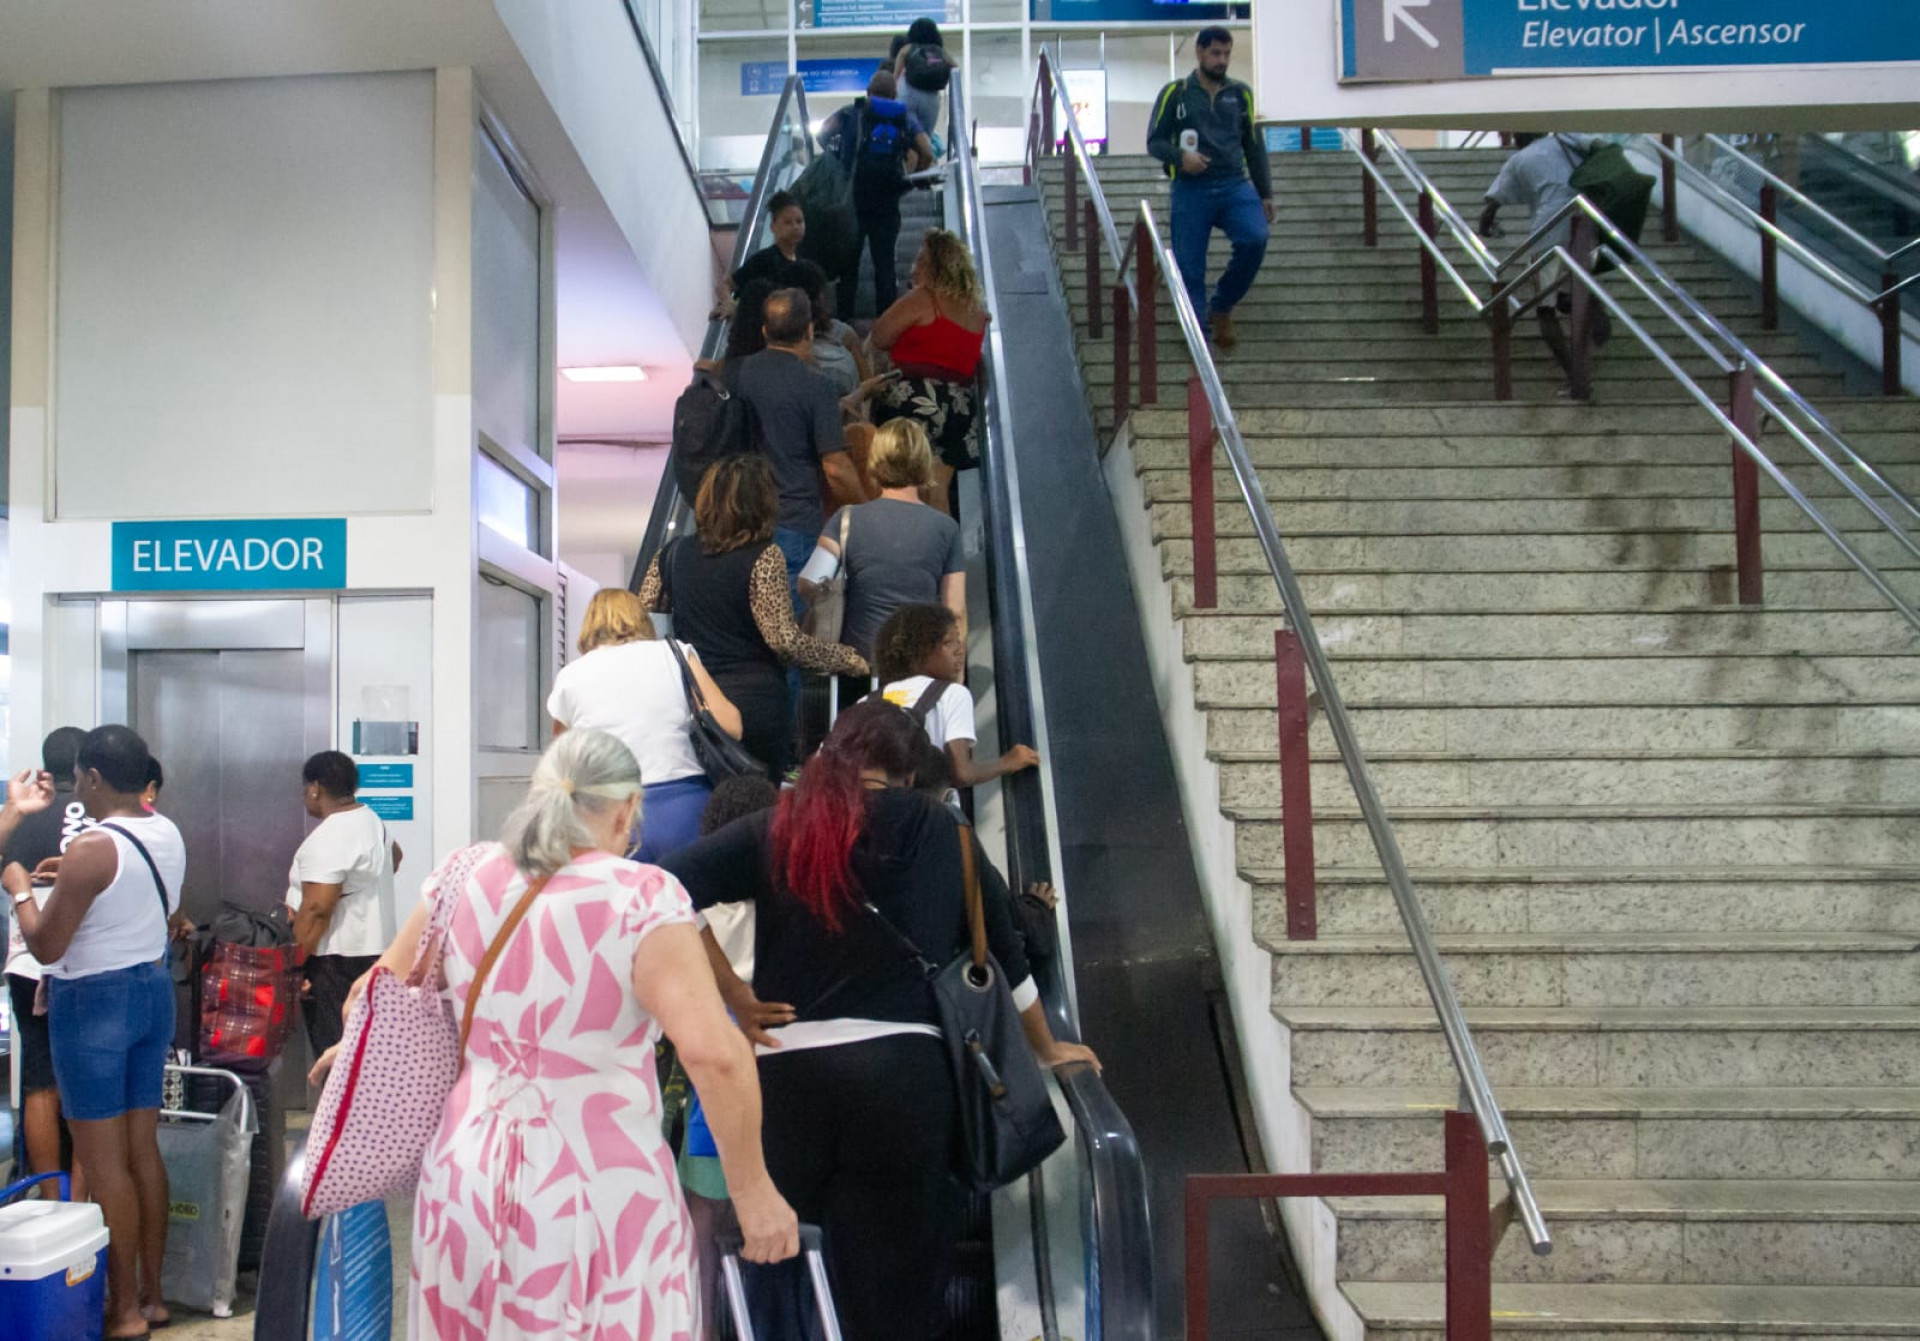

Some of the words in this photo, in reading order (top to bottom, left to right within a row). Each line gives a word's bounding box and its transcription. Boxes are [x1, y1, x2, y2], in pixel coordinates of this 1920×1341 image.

[1522, 19, 1648, 48] Elevator
[1667, 18, 1806, 45] Ascensor
[133, 536, 324, 572] ELEVADOR
